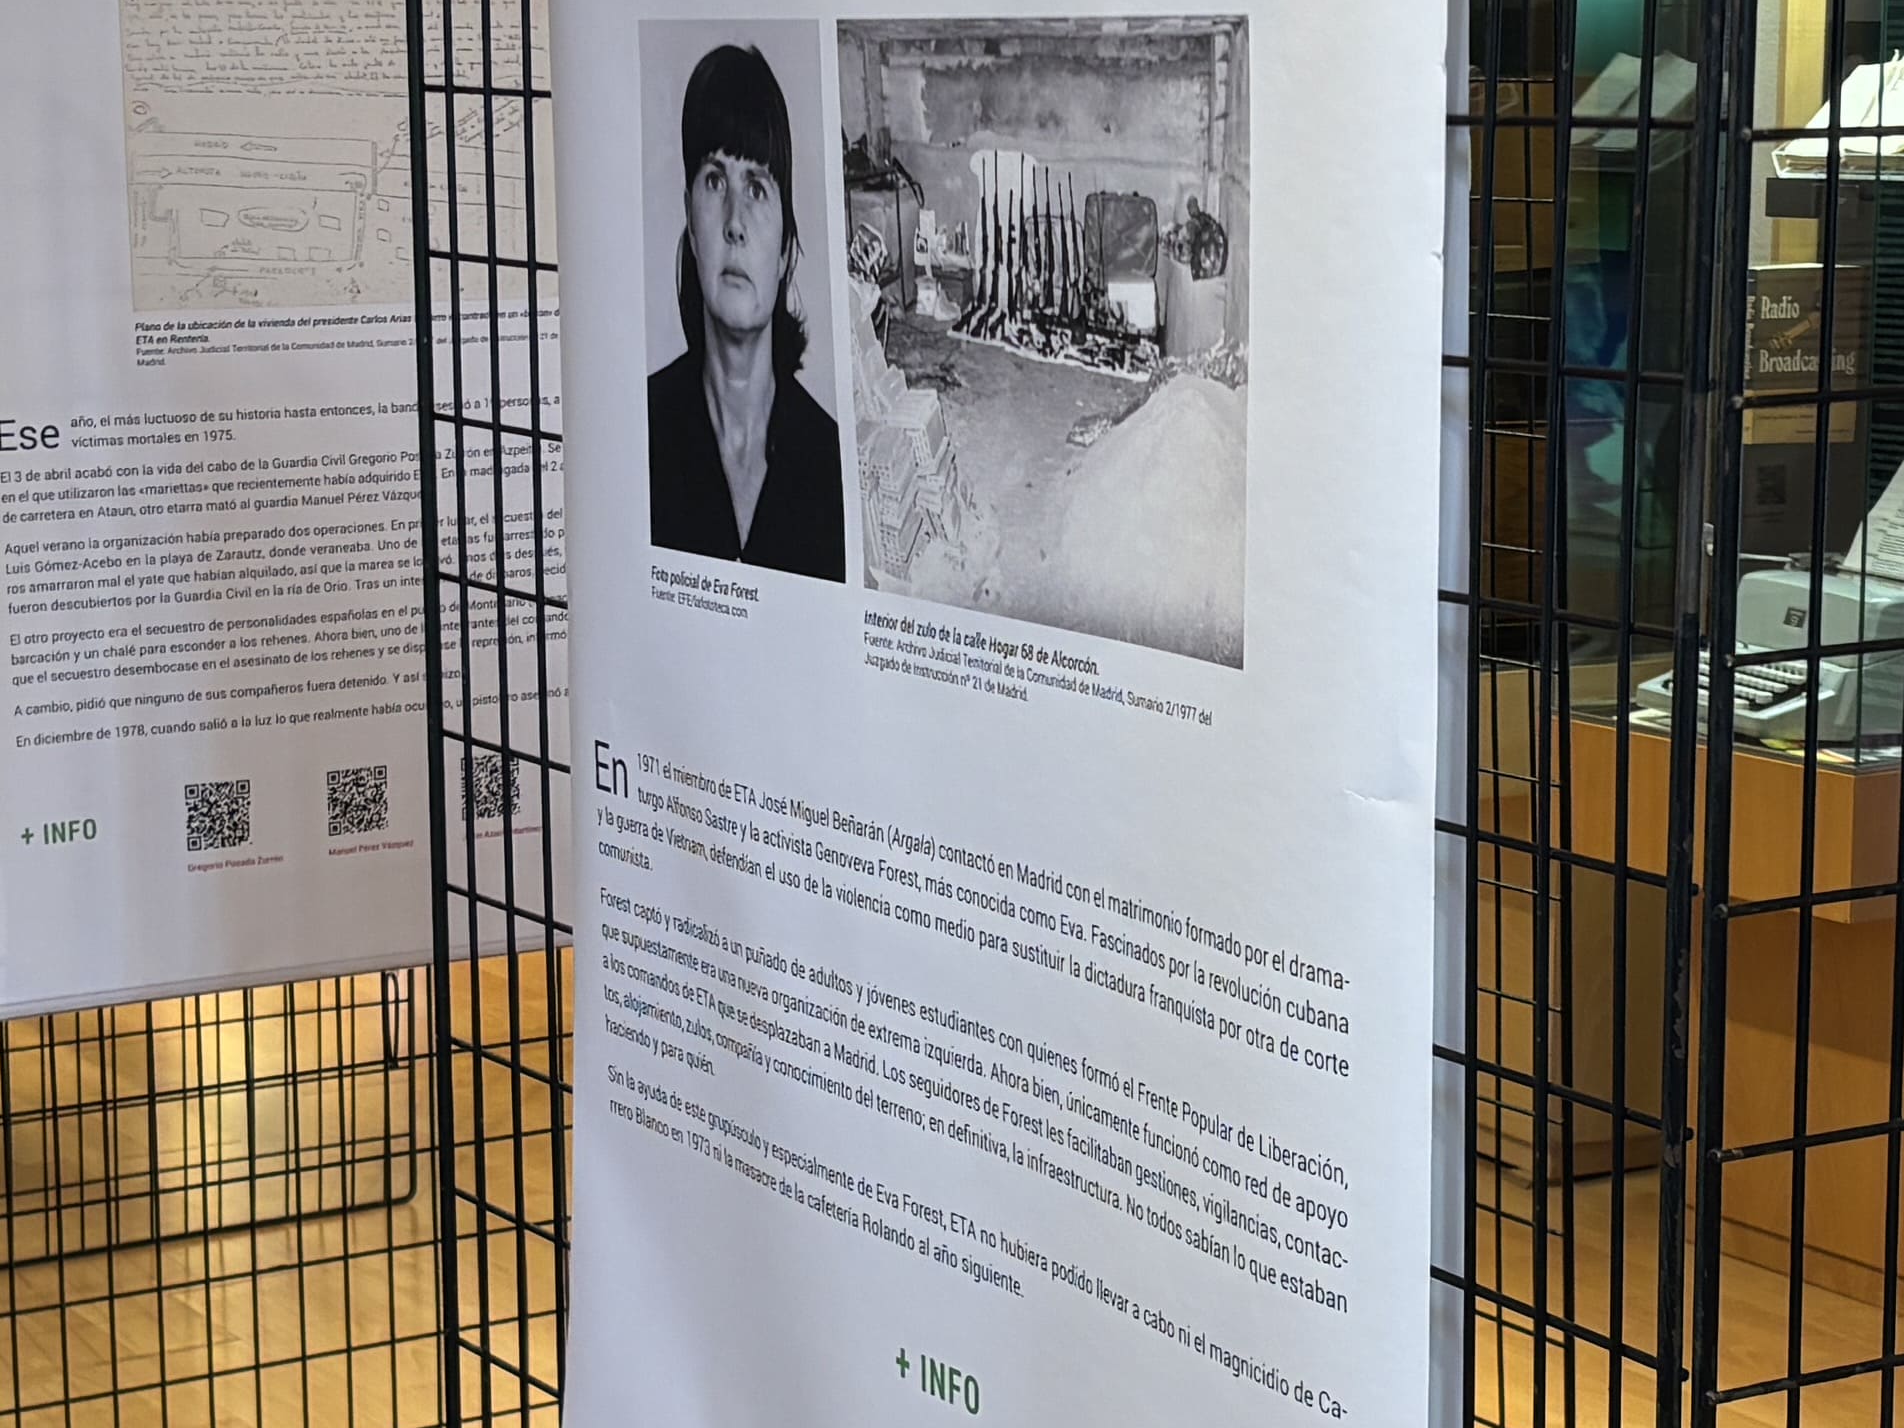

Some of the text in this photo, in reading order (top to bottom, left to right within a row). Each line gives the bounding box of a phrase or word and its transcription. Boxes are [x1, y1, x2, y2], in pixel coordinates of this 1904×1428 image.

[1760, 295, 1800, 320] Radio
[134, 322, 161, 331] Plano
[163, 321, 175, 331] de
[176, 321, 186, 330] la
[187, 320, 232, 330] ubicación
[234, 319, 245, 328] de
[247, 319, 256, 328] la
[258, 317, 295, 327] vivienda
[297, 317, 311, 326] del
[312, 316, 358, 328] presidente
[360, 314, 387, 324] Carlos
[1758, 348, 1856, 375] Broadcaing
[70, 415, 96, 428] año,
[100, 414, 110, 427] el
[114, 413, 140, 426] más
[144, 412, 197, 425] luctuoso
[200, 411, 215, 422] de
[218, 412, 233, 421] su
[236, 408, 280, 420] historia
[284, 406, 316, 418] hasta
[320, 405, 375, 416] entonces,
[378, 402, 388, 413] la
[71, 429, 236, 447] víctimas mortales en 1975.
[44, 818, 96, 844] INFO
[594, 739, 1350, 990] En 1971 el miembro de ETA José Miguel Beñarán (Argala) contactó en Madrid con el matrimonio formado por el drama-
[920, 1354, 979, 1415] INFO
